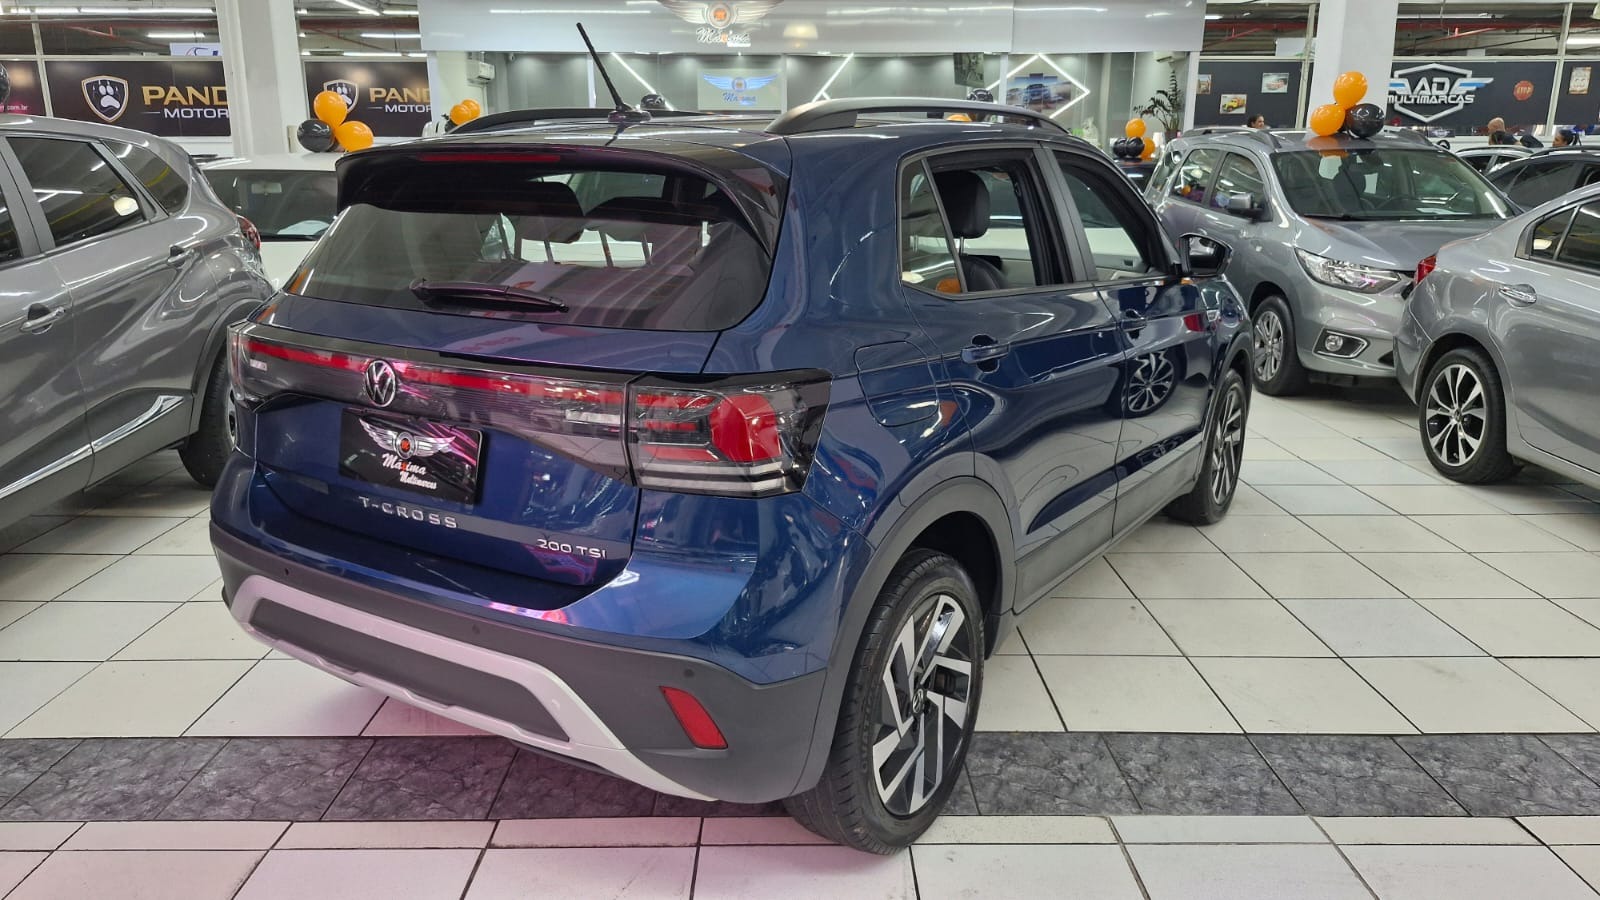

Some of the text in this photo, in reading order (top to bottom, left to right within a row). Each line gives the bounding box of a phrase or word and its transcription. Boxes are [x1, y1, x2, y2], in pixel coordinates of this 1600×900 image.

[358, 496, 457, 528] T-CROSS
[537, 538, 606, 558] 200 TSI
